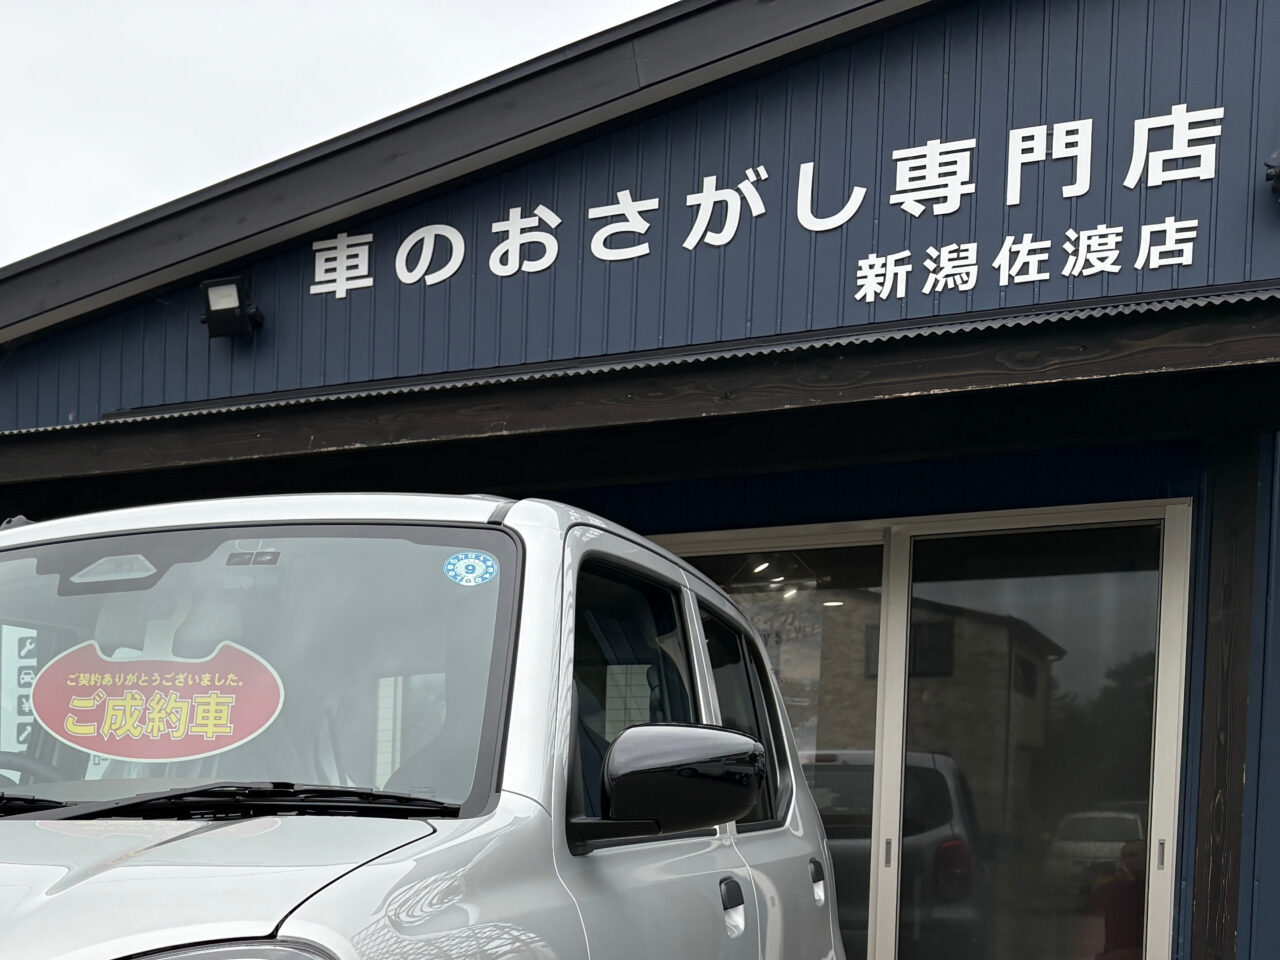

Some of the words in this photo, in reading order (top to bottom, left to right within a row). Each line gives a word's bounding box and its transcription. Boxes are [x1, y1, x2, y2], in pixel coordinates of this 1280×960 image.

[309, 103, 1225, 299] 車のおさがし専門店
[853, 215, 1199, 303] 新潟佐渡店
[464, 563, 477, 575] 9
[66, 672, 244, 687] ご契約ありがとうございました。
[64, 688, 236, 742] ご成約車
